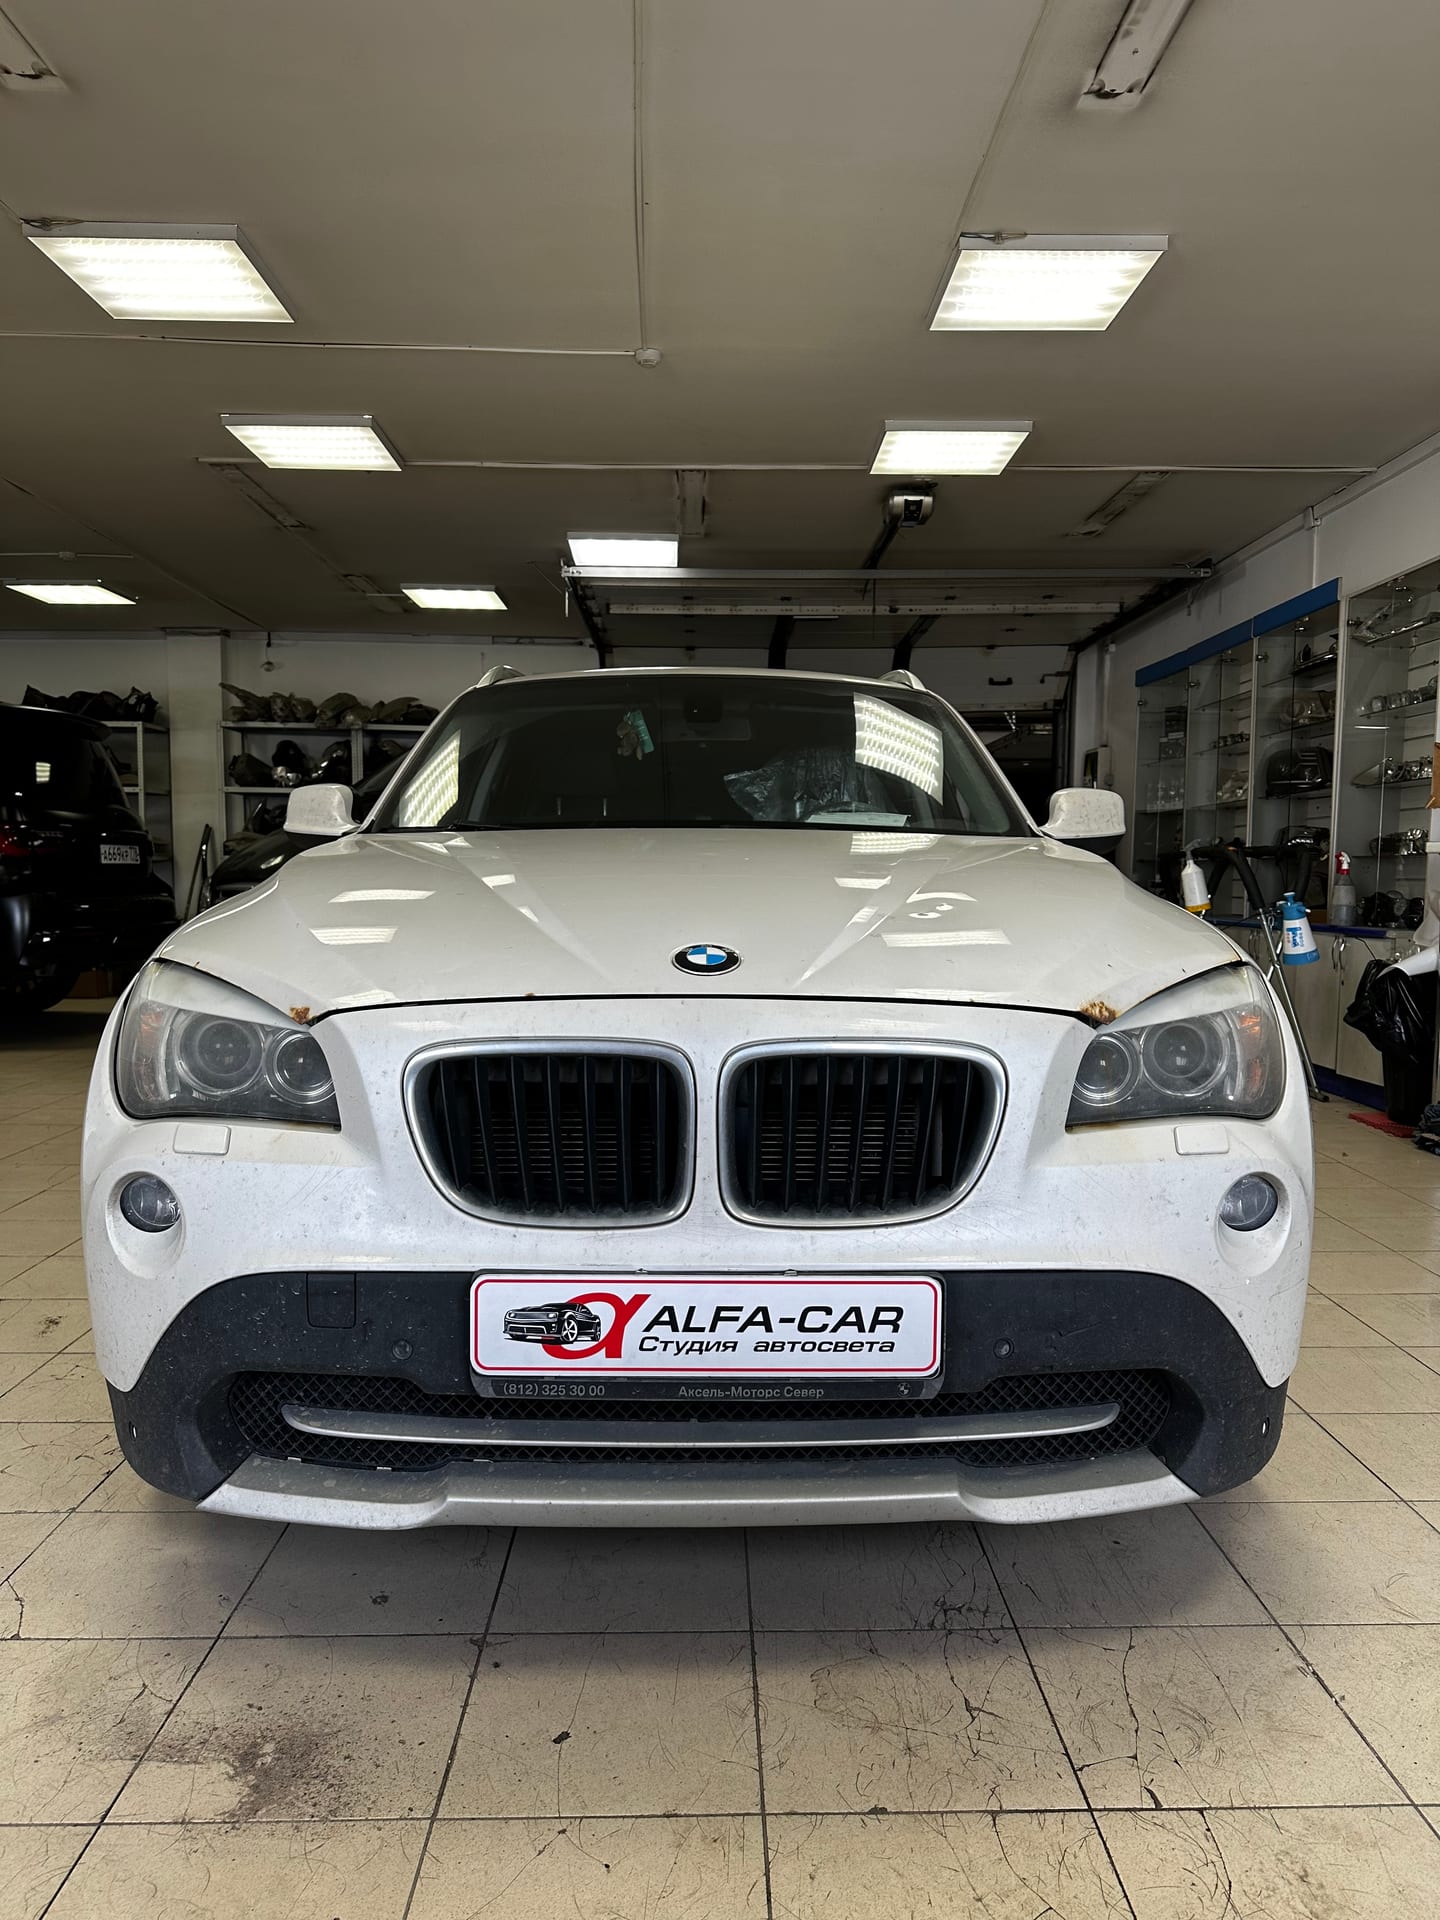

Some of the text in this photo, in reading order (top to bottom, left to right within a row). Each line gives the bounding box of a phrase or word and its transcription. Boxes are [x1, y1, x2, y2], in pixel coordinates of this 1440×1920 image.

[642, 1305, 904, 1333] ALFA-CAR
[638, 1336, 895, 1356] Студия автосвета
[503, 1382, 605, 1396] (812) 325 30 00
[678, 1386, 825, 1399] Аксель-Моторс Север
